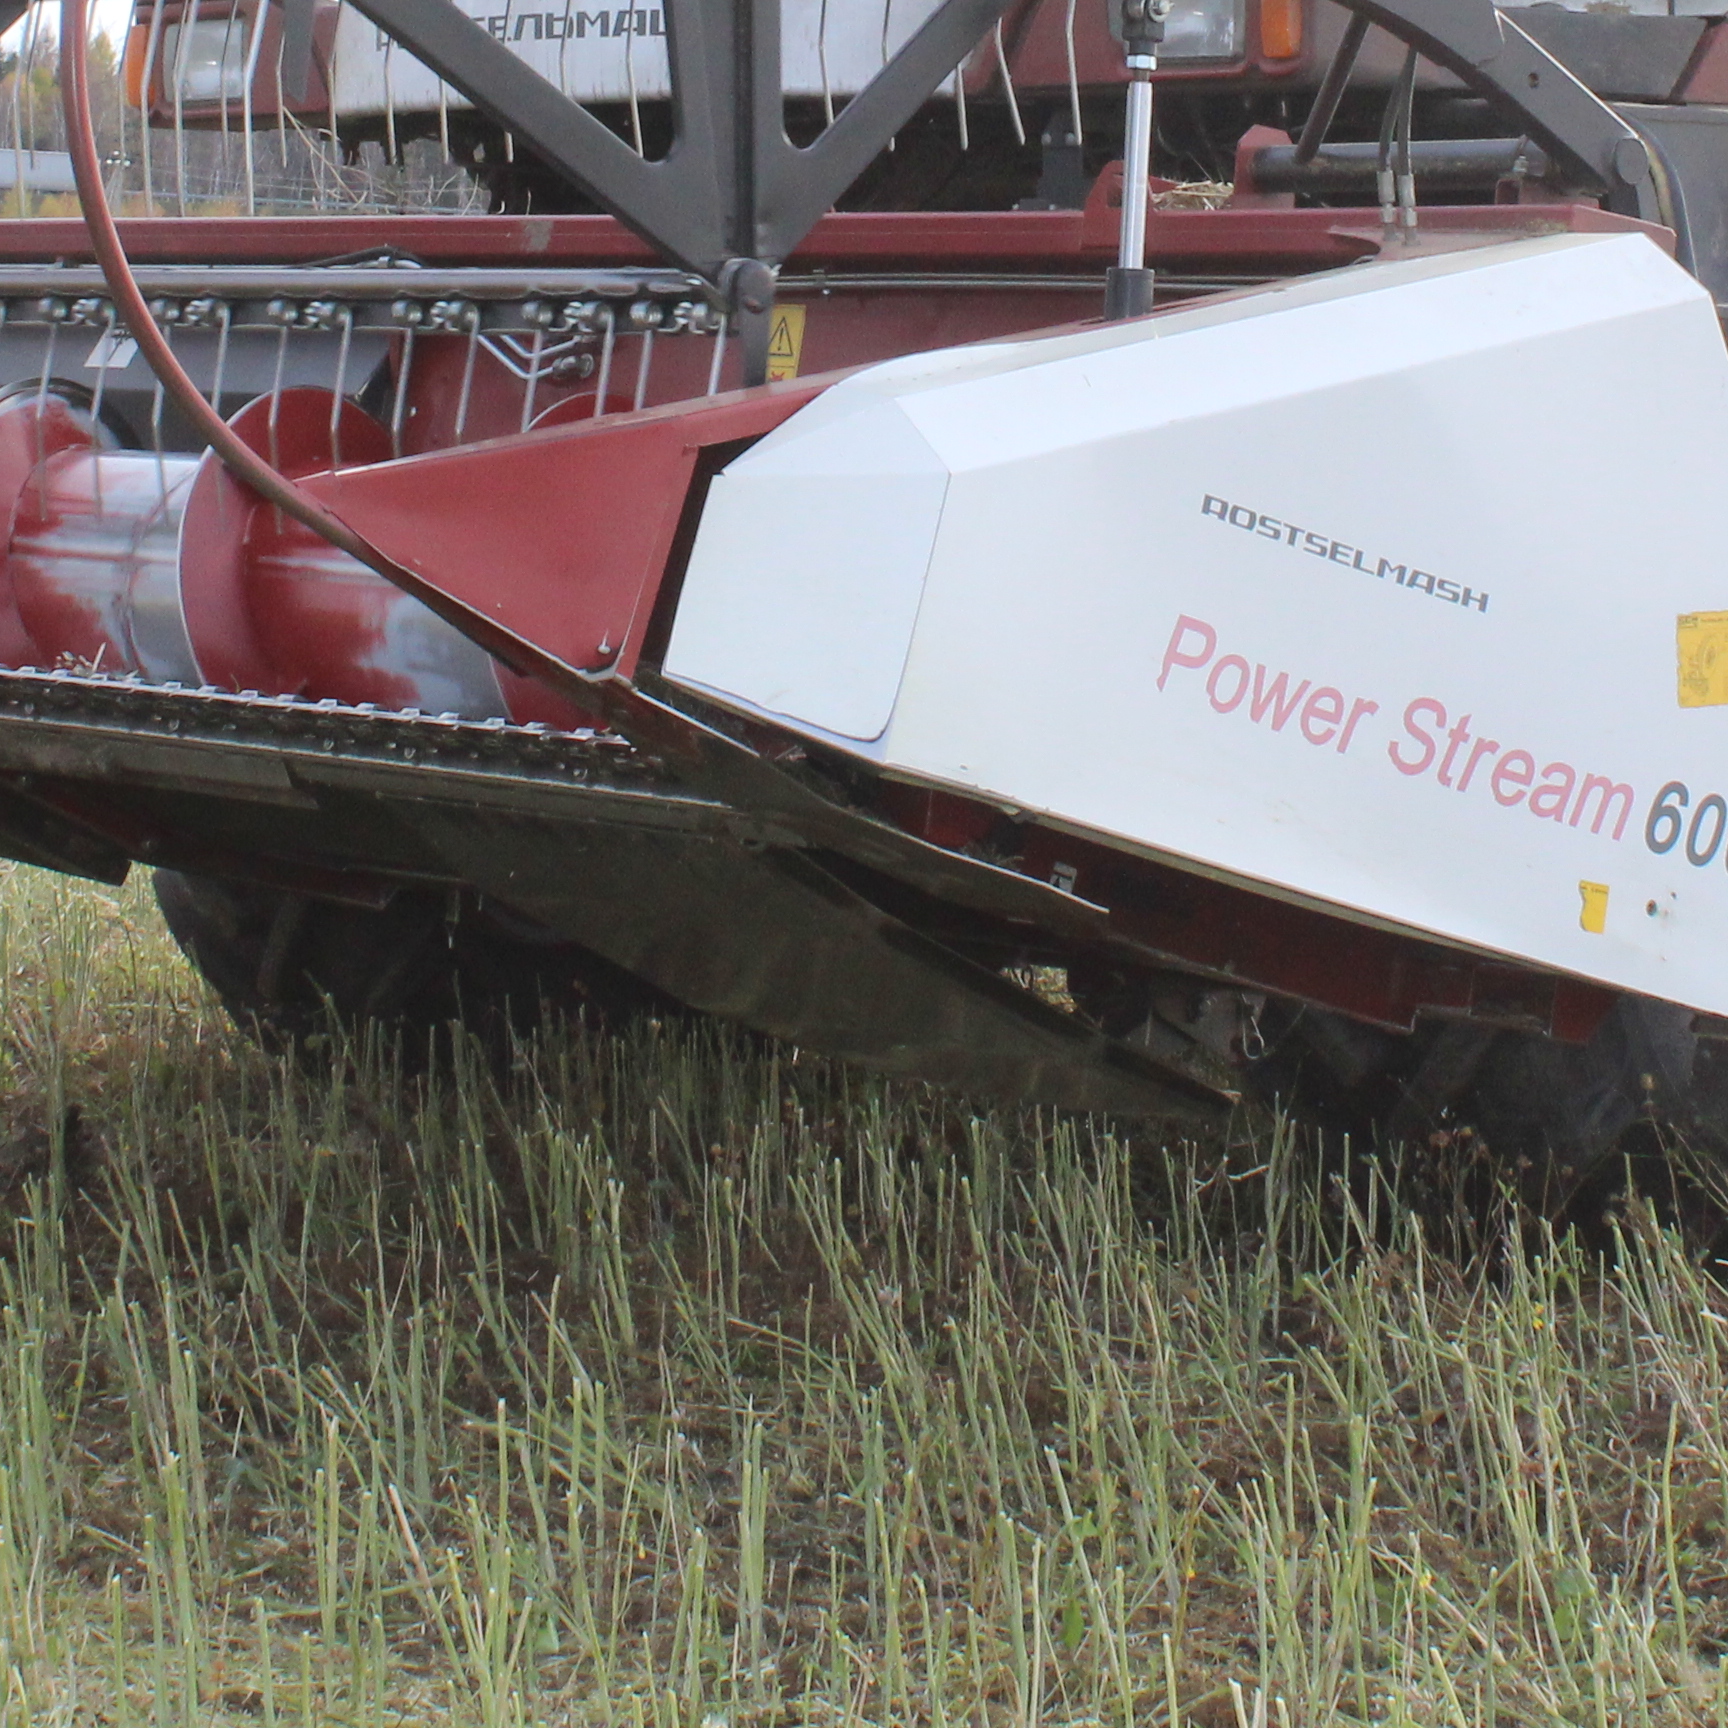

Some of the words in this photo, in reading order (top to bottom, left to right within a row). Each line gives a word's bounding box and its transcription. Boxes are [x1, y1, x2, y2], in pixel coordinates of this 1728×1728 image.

[1200, 493, 1489, 613] ROSTSELMASH
[1156, 614, 1379, 754] Power
[1388, 697, 1635, 841] Stream
